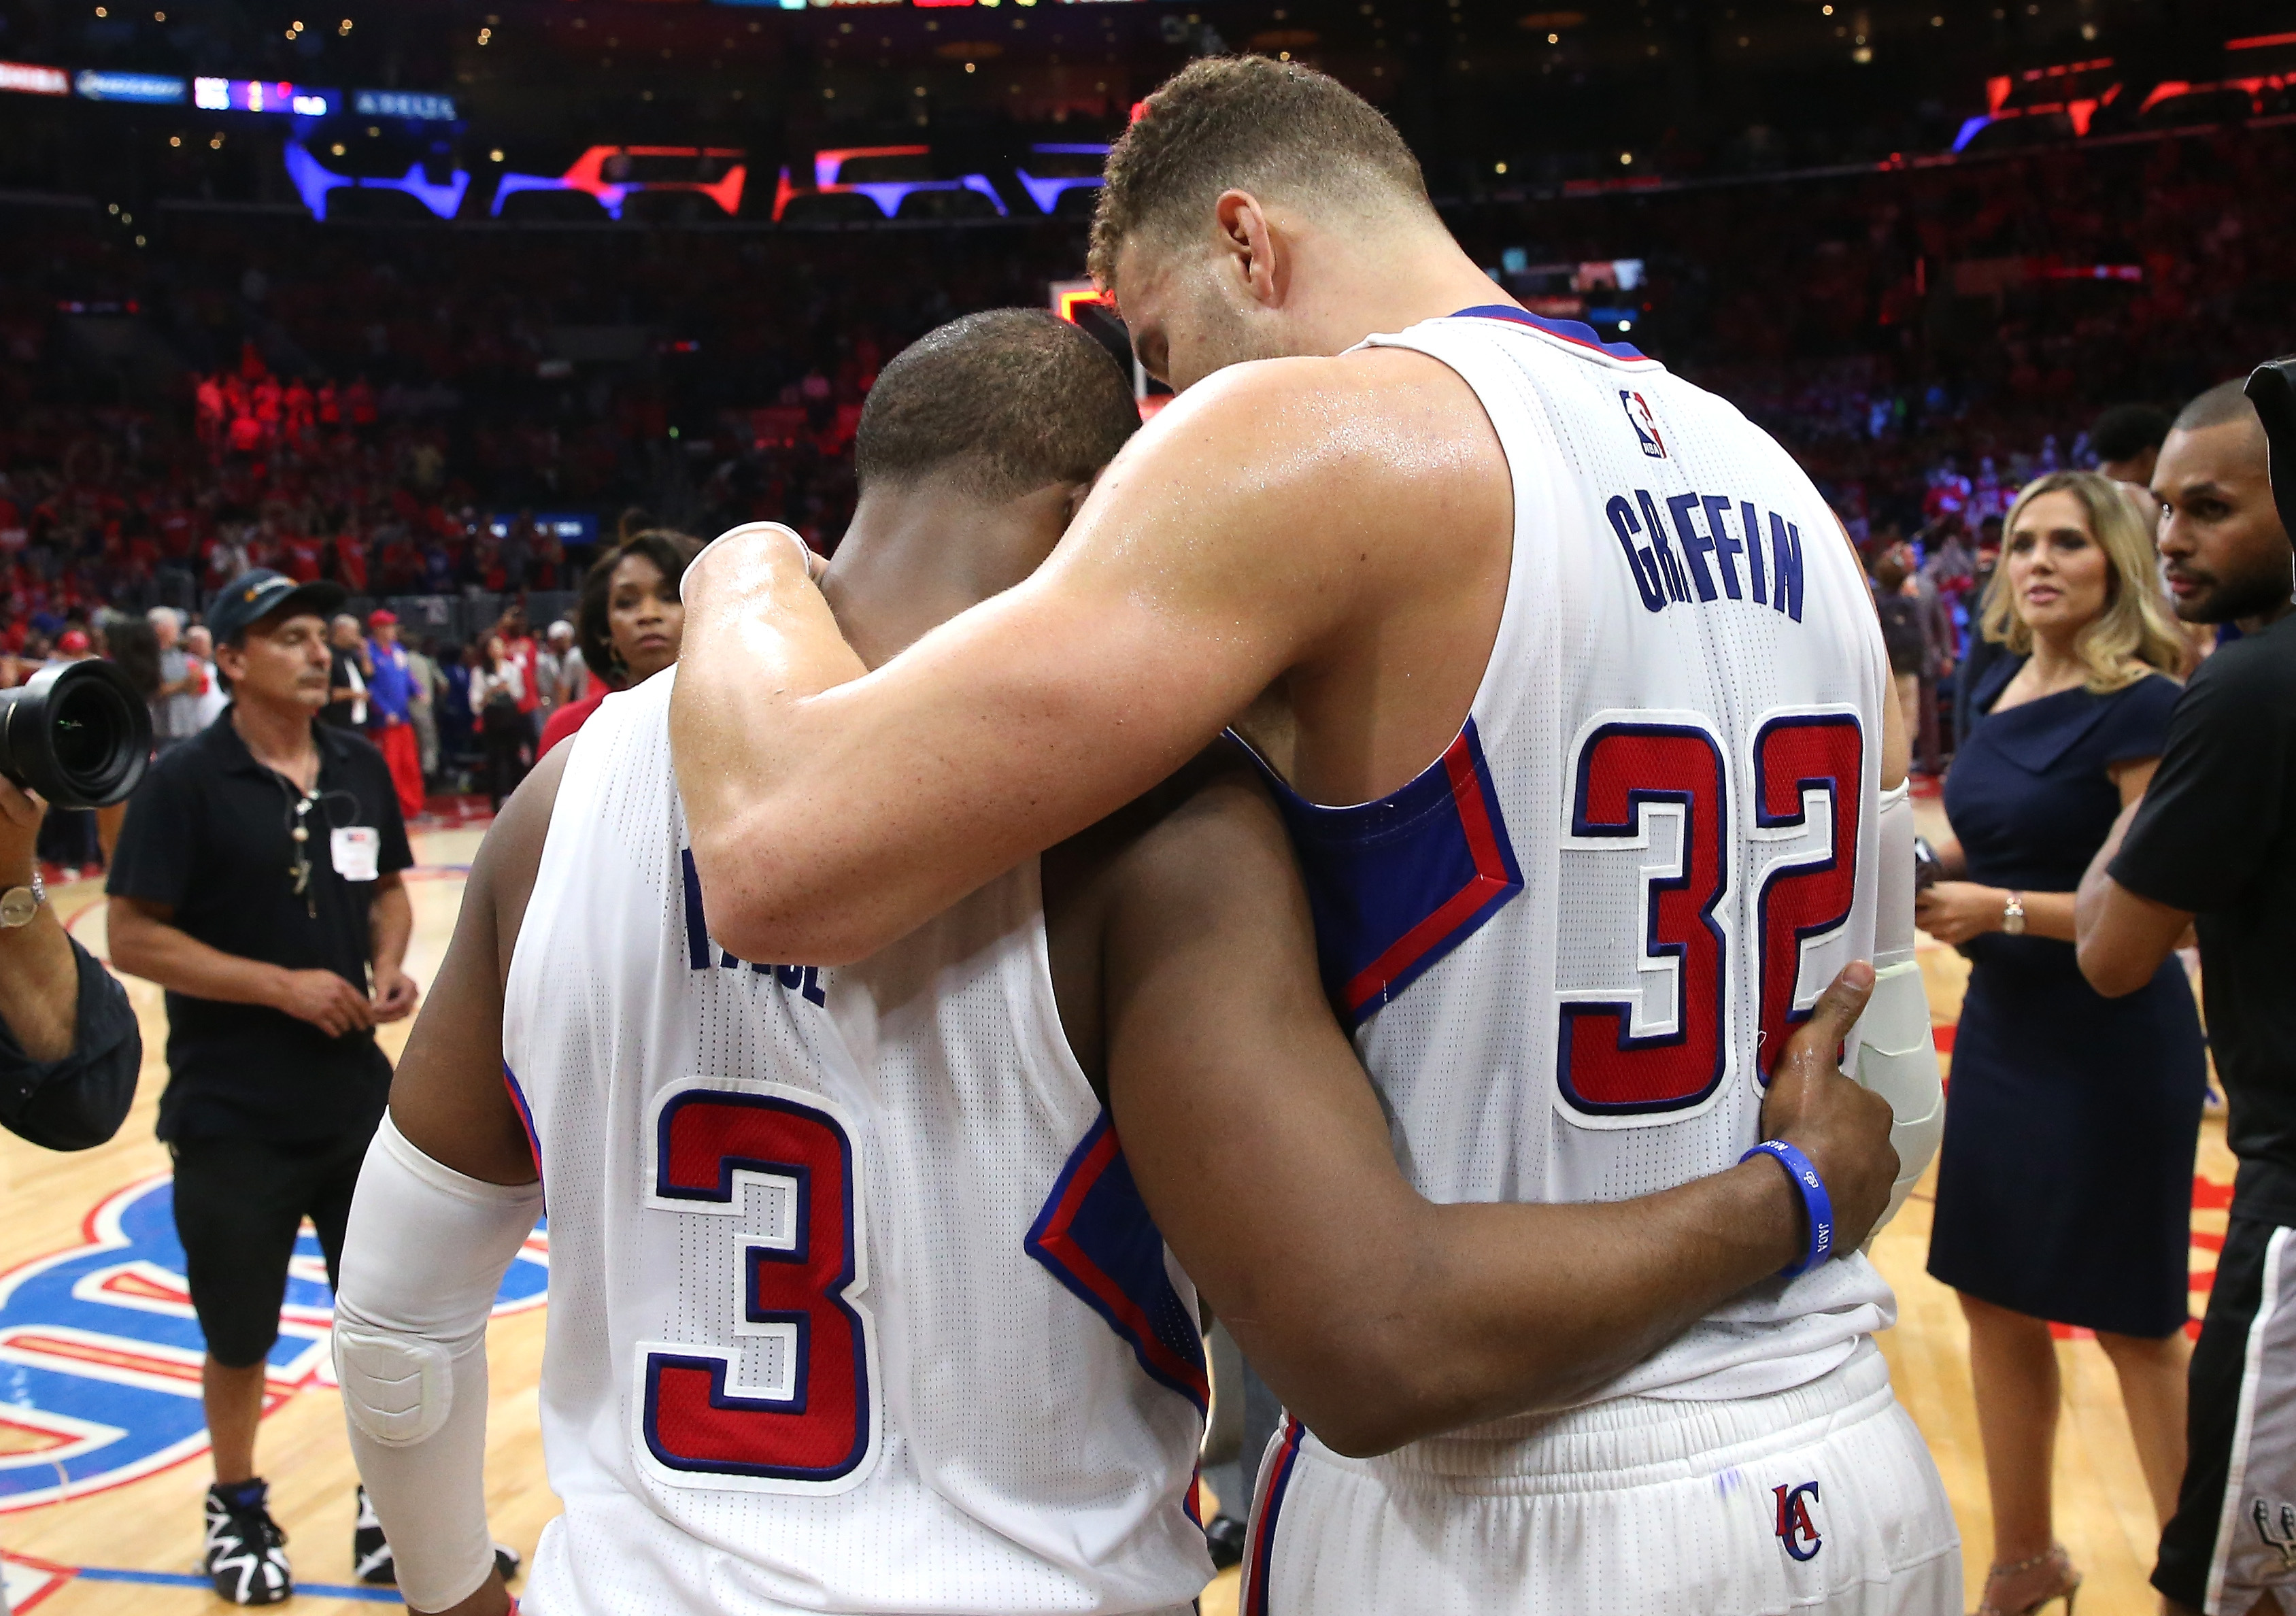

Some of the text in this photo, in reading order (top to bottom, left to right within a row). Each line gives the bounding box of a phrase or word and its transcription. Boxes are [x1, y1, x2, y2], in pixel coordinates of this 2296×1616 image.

[1642, 442, 1661, 458] NBA
[1606, 489, 1804, 623] GRFFIN
[1553, 703, 1865, 1129] 32
[632, 1077, 883, 1496] 3
[1817, 1223, 1829, 1252] JADA
